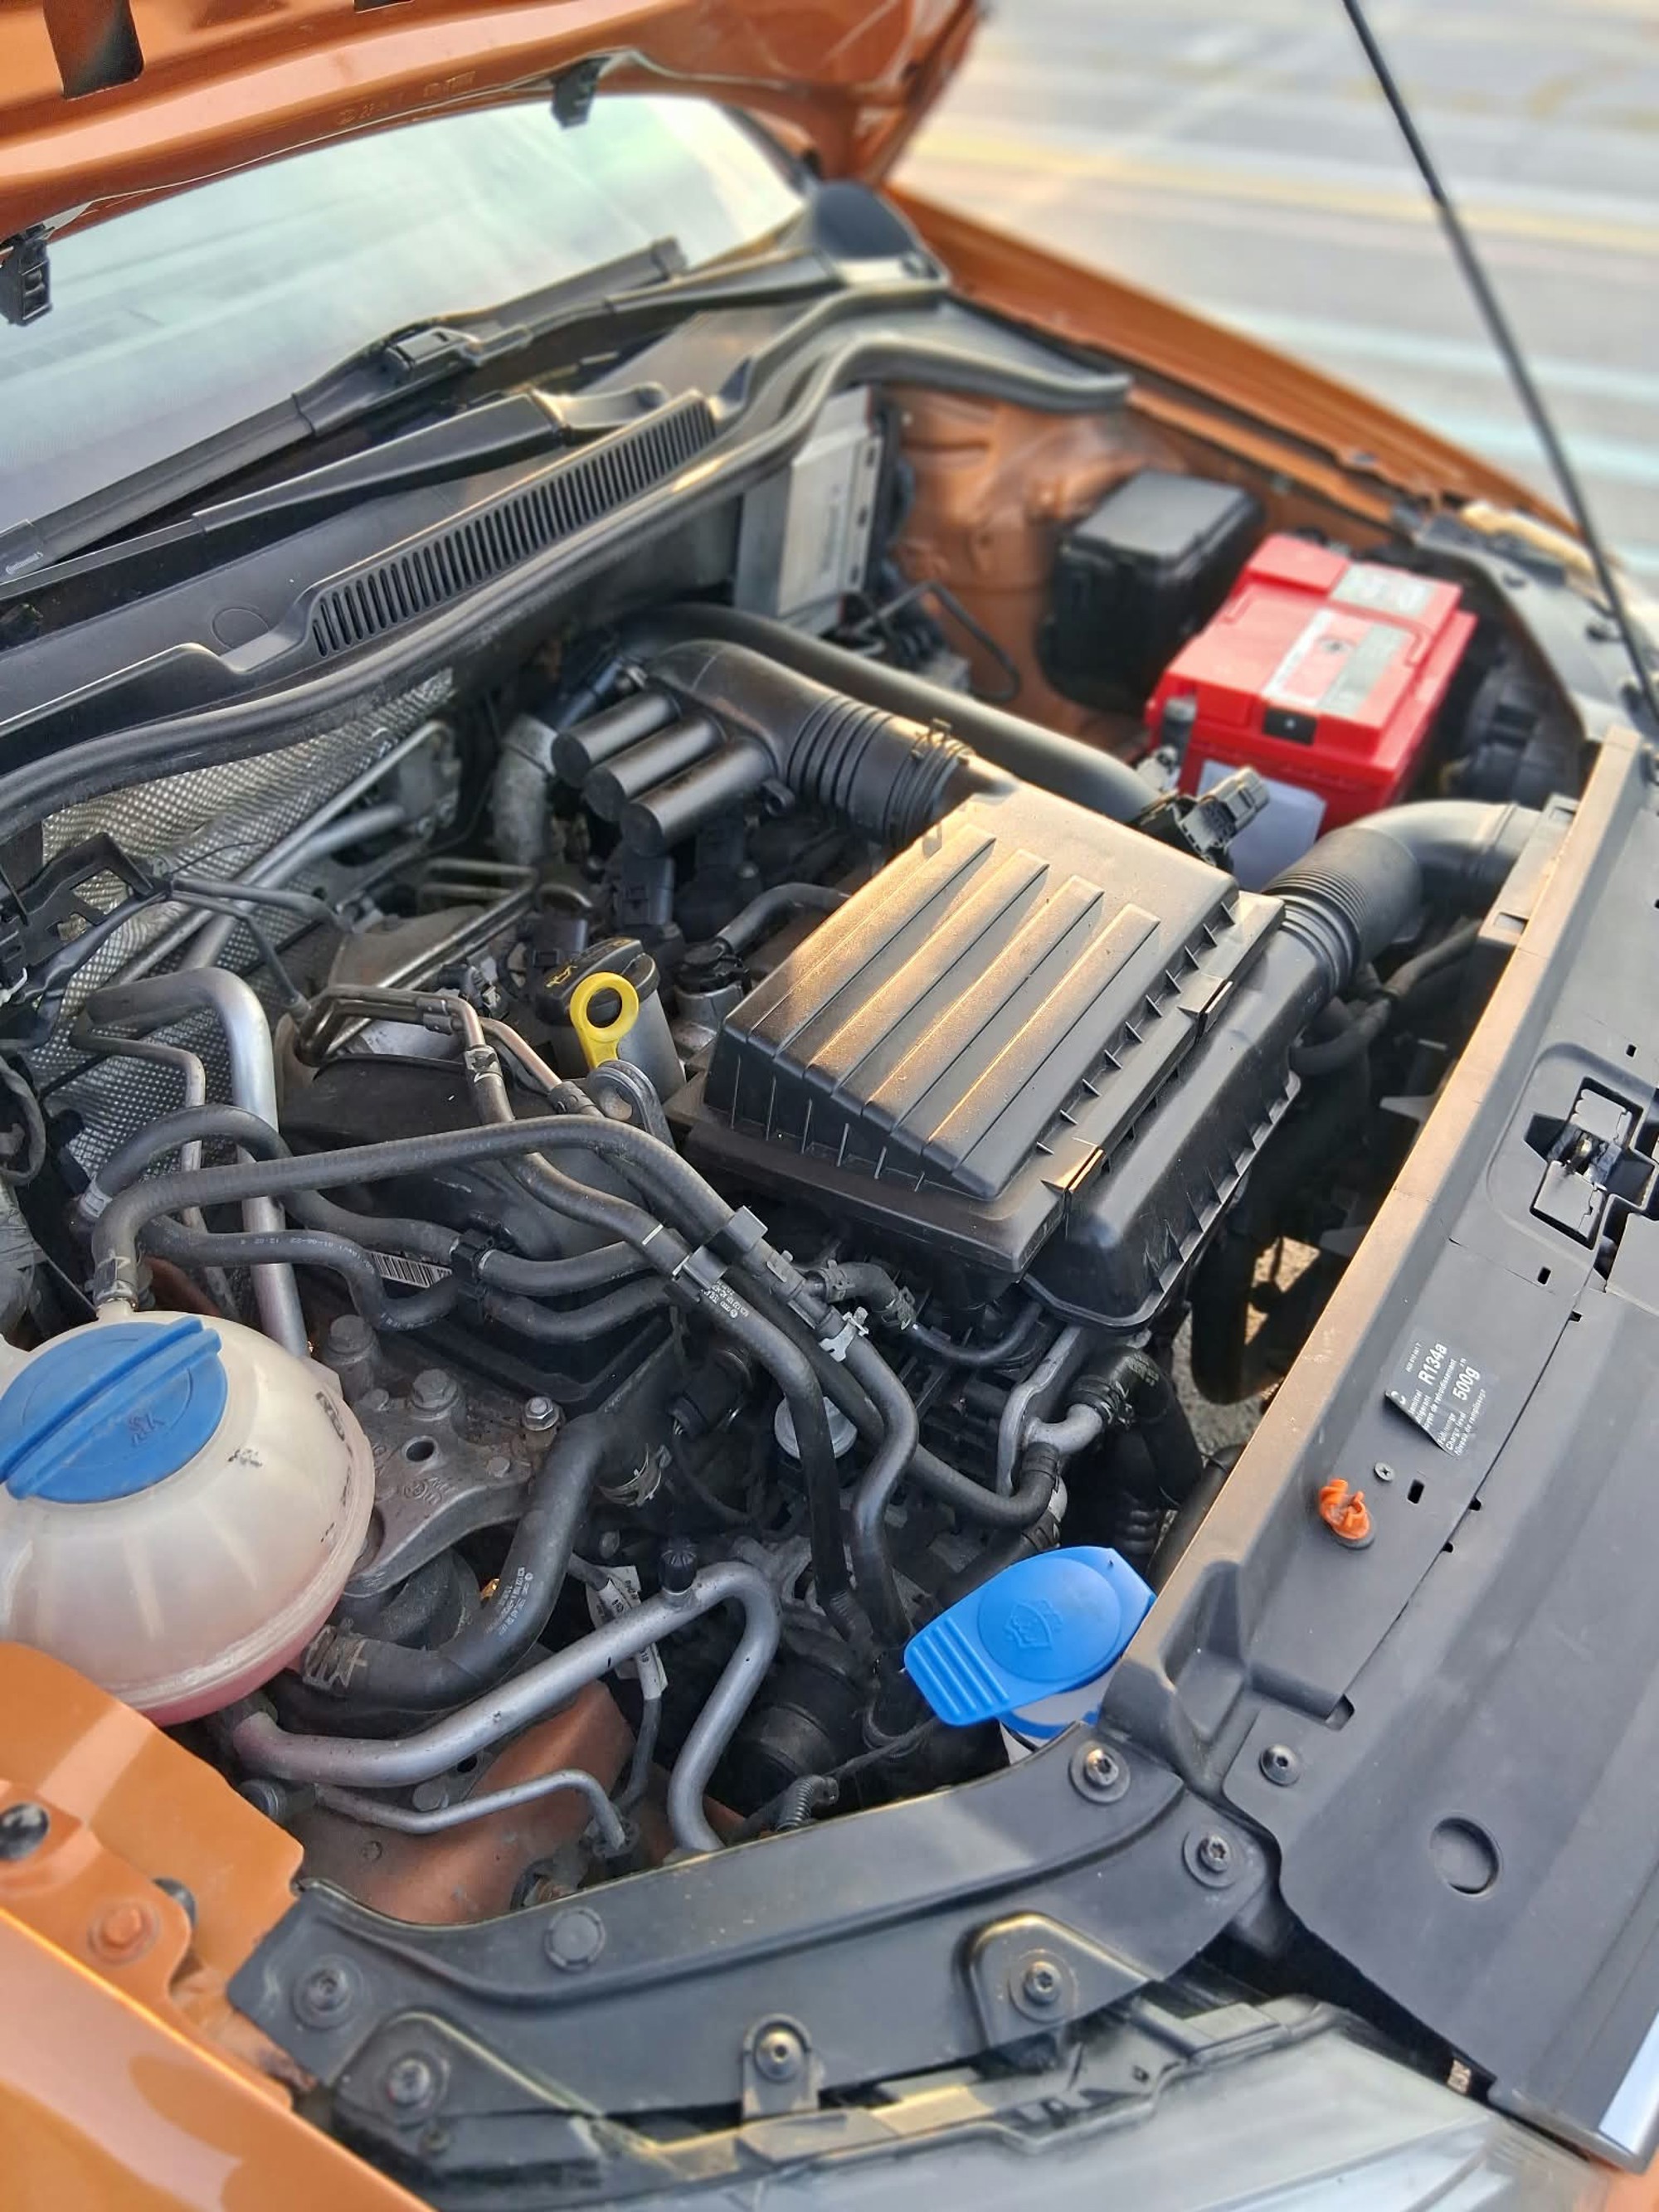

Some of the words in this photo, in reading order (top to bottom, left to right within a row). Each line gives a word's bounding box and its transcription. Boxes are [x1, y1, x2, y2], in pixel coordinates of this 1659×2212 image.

[1418, 1343, 1447, 1385] R134a
[1452, 1366, 1481, 1401] 500g
[1445, 1427, 1460, 1450] Charge
[1455, 1411, 1467, 1427] level
